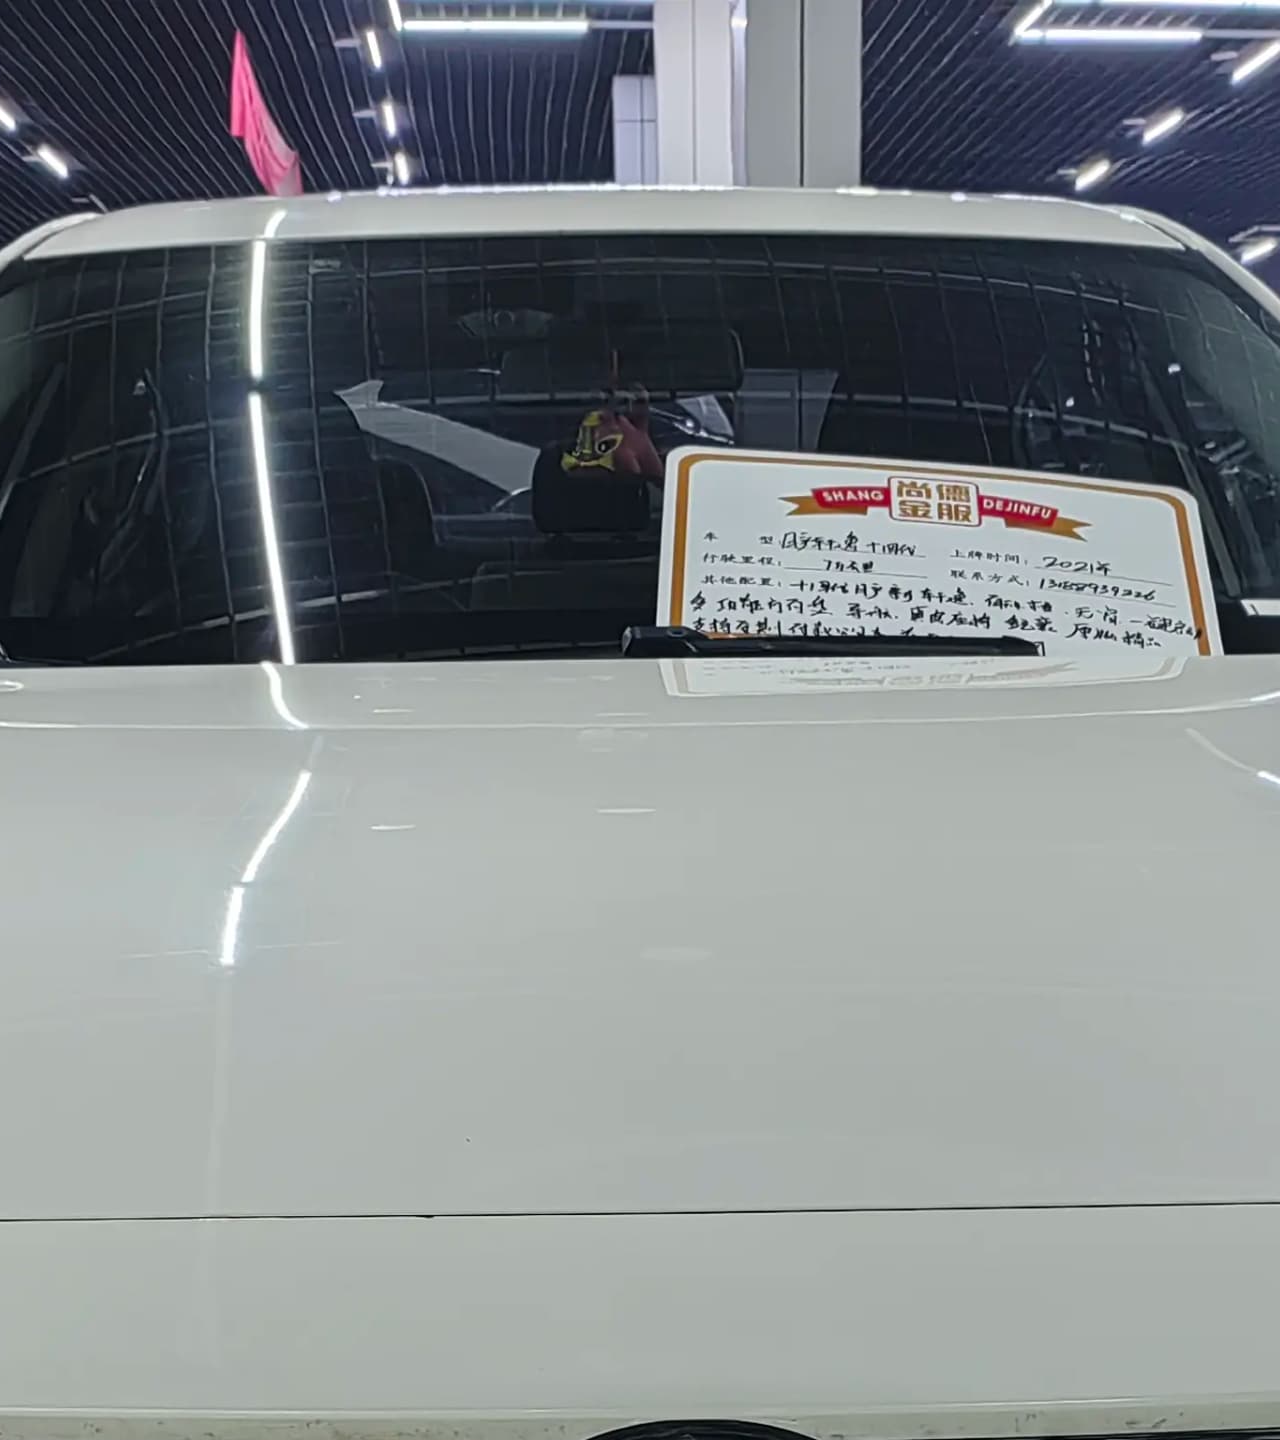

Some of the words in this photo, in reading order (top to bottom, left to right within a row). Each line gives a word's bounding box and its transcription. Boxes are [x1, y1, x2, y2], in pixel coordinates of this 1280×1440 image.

[897, 481, 971, 501] 尚德
[822, 489, 885, 503] SHANG
[982, 499, 1053, 520] DEJINFU
[898, 500, 972, 524] 金服
[1042, 556, 1112, 576] 2021年
